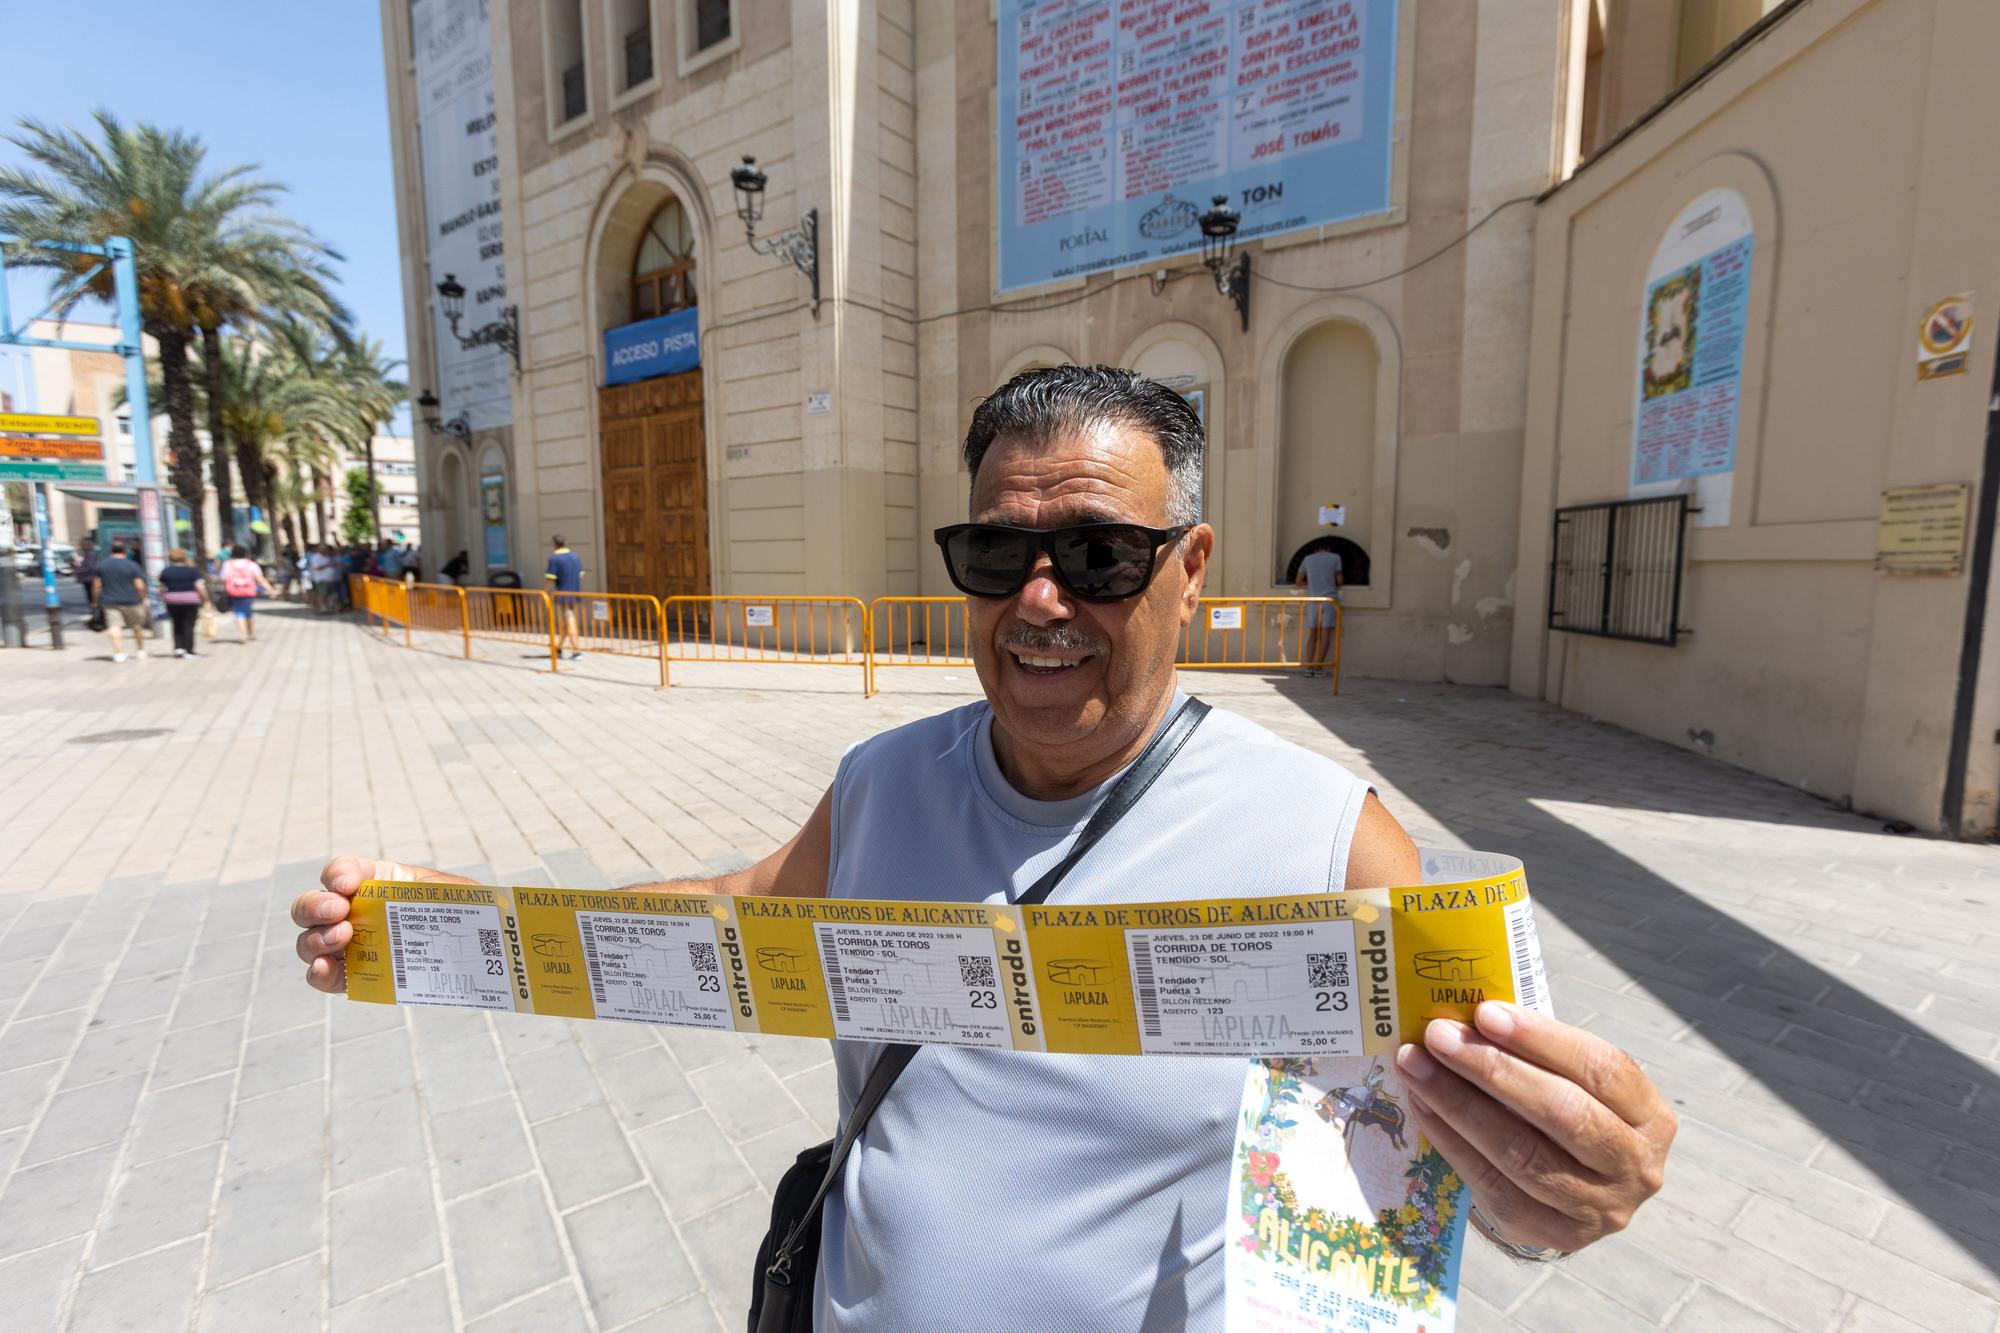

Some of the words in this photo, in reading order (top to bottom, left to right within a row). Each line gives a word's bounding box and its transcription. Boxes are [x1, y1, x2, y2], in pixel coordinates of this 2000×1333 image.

[1251, 134, 1285, 159] JOSÉ
[1293, 120, 1340, 147] TOMÁS
[612, 340, 659, 366] ACCESO
[663, 331, 697, 354] PISTA
[377, 886, 389, 898] DE
[391, 886, 424, 900] TOROS
[427, 888, 440, 900] DE
[442, 889, 495, 903] ALICANTE
[1402, 889, 1478, 913] PLAZA
[1485, 883, 1508, 905] DE
[519, 892, 559, 907] PLAZA
[561, 894, 578, 908] DE
[580, 895, 620, 910] TOROS
[623, 897, 640, 911] DE
[642, 898, 709, 914] ALICANTE
[741, 902, 793, 919] PLAZA
[796, 904, 816, 919] DE
[819, 905, 871, 921] TOROS
[875, 906, 896, 921] DE
[902, 907, 988, 925] ALICANTE
[1032, 910, 1098, 928] PLAZA
[1104, 910, 1129, 926] DE
[1134, 907, 1200, 926] TOROS
[1207, 905, 1233, 923] DE
[1241, 899, 1348, 921] ALICANTE
[594, 926, 627, 934] CORRIDA
[629, 927, 640, 935] DE
[640, 928, 666, 936] TOROS
[1153, 934, 1187, 942] JUEVES,
[1216, 932, 1242, 940] JUNIO
[597, 935, 624, 943] TENDIDO
[628, 936, 642, 944] SOL
[838, 938, 879, 947] CORRIDA
[881, 940, 894, 948] DE
[897, 940, 930, 949] TOROS
[1154, 944, 1206, 953] CORRIDA
[1211, 943, 1227, 951] DE
[1230, 941, 1272, 951] TOROS
[356, 950, 378, 962] LAPLAZA
[504, 916, 529, 999] entrada
[600, 952, 623, 960] Tendido
[840, 948, 875, 957] TENDIDO
[1156, 956, 1200, 964] TENDIDO
[1210, 955, 1231, 963] SOL
[486, 959, 504, 976] 23
[543, 962, 572, 975] LAPLAZA
[721, 927, 752, 1018] entrada
[843, 967, 874, 975] Tendido
[427, 972, 477, 995] LAPLAZA
[697, 975, 721, 992] 23
[771, 977, 807, 991] LAPLAZA
[845, 976, 870, 985] Puerta
[1002, 939, 1036, 1035] entrada
[1361, 929, 1393, 1037] entrada
[847, 986, 871, 994] SILLÓN
[1064, 991, 1109, 1005] LAPLAZA
[1160, 987, 1190, 995] Puerta
[1432, 988, 1485, 1004] LAPLAZA
[630, 987, 688, 1012] LAPLAZA
[969, 990, 997, 1009] 23
[1161, 997, 1190, 1005] SILLÓN
[1315, 991, 1348, 1012] 23
[880, 1004, 953, 1030] LAPLAZA
[962, 1031, 983, 1039] 25,00
[1202, 1014, 1292, 1041] LAPLAZA
[1301, 1038, 1327, 1046] 25,00
[1259, 1207, 1420, 1296] ALICANTE
